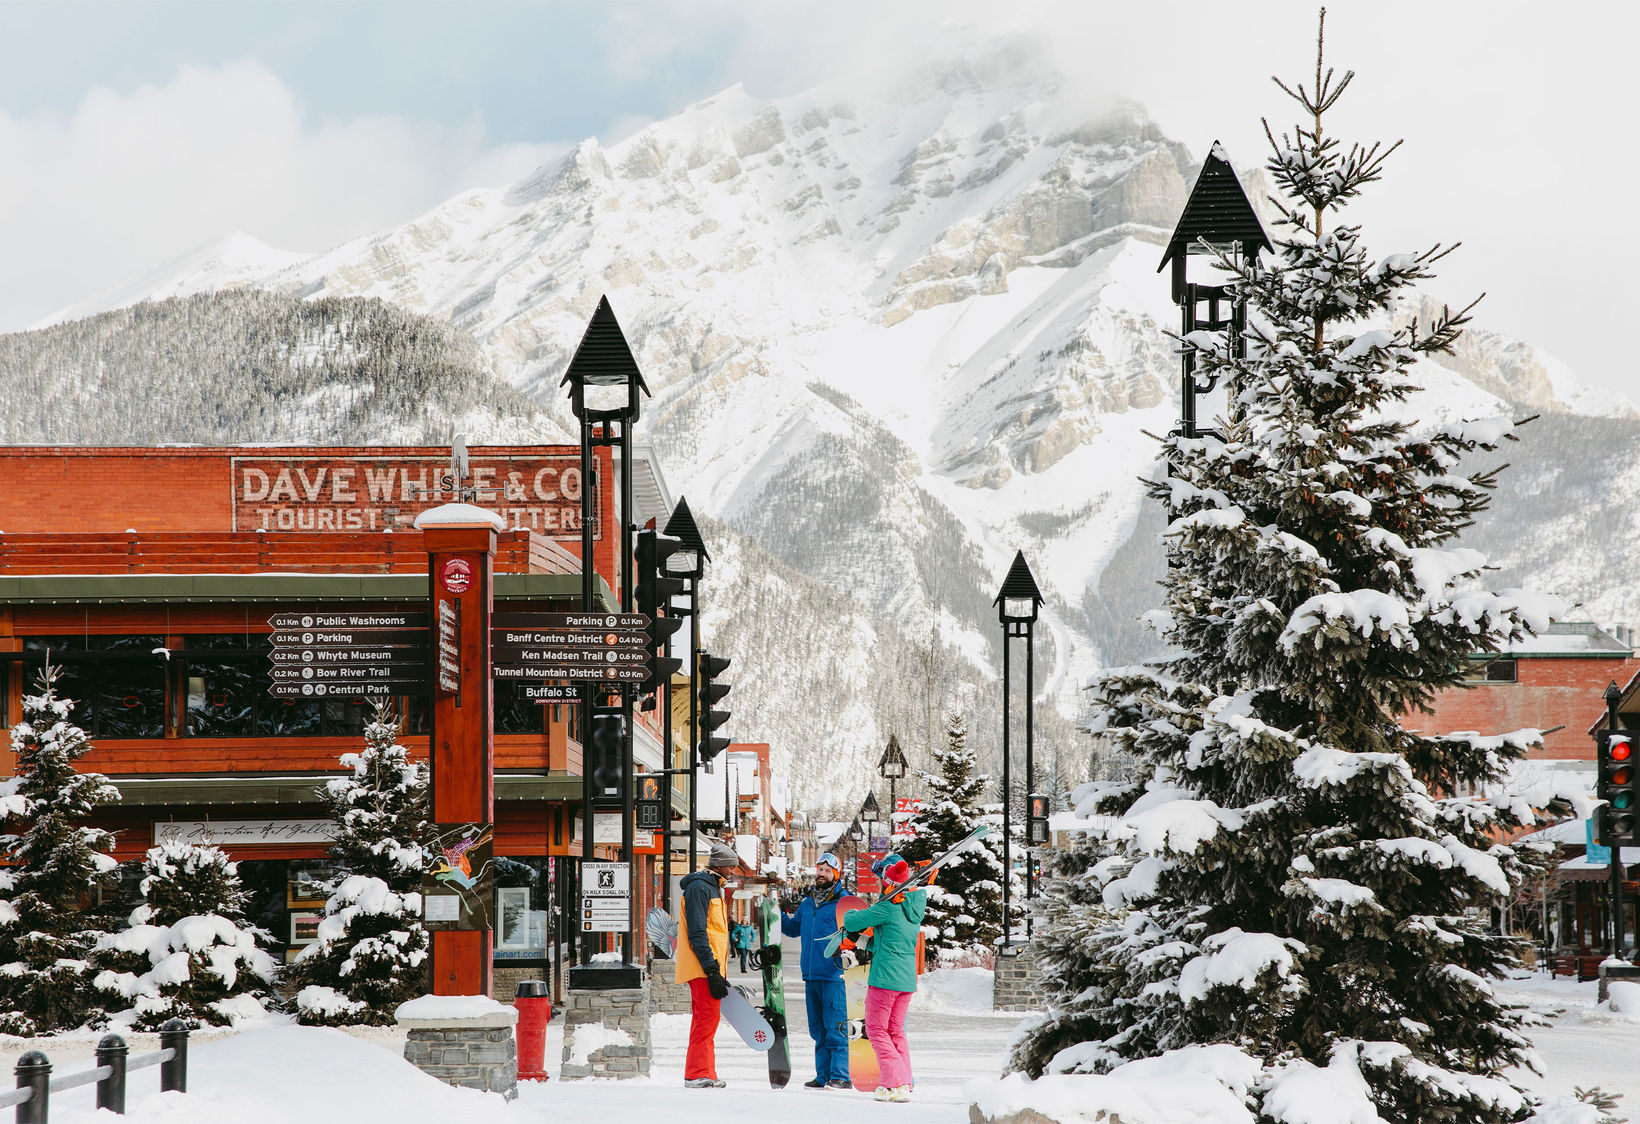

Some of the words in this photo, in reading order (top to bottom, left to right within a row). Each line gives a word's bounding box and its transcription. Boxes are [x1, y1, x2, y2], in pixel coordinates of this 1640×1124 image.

[243, 467, 357, 502] DAVE
[507, 472, 530, 501] &
[257, 508, 383, 531] TOURIST
[316, 617, 347, 626] Public
[349, 616, 406, 625] Washrooms
[566, 616, 603, 627] Parking
[317, 634, 353, 643] Parking
[506, 634, 532, 643] Banff
[534, 634, 565, 643] Centre
[567, 634, 603, 644] District
[618, 636, 630, 644] 0.4
[631, 636, 643, 644] Km
[317, 651, 348, 661] Whyte
[351, 651, 392, 660] Museum
[522, 651, 540, 660] Ken
[543, 651, 579, 660] Madsen
[582, 651, 603, 660] Trail
[631, 653, 643, 661] Km
[317, 668, 337, 677] Bow
[340, 668, 366, 677] River
[369, 667, 391, 676] Trail
[494, 667, 523, 676] Tunnel
[526, 668, 567, 677] Mountain
[569, 668, 603, 678] District
[328, 685, 364, 694] Central
[367, 685, 390, 694] Park
[526, 687, 563, 698] Buffalo
[565, 687, 578, 697] St
[187, 822, 254, 838] Mountain
